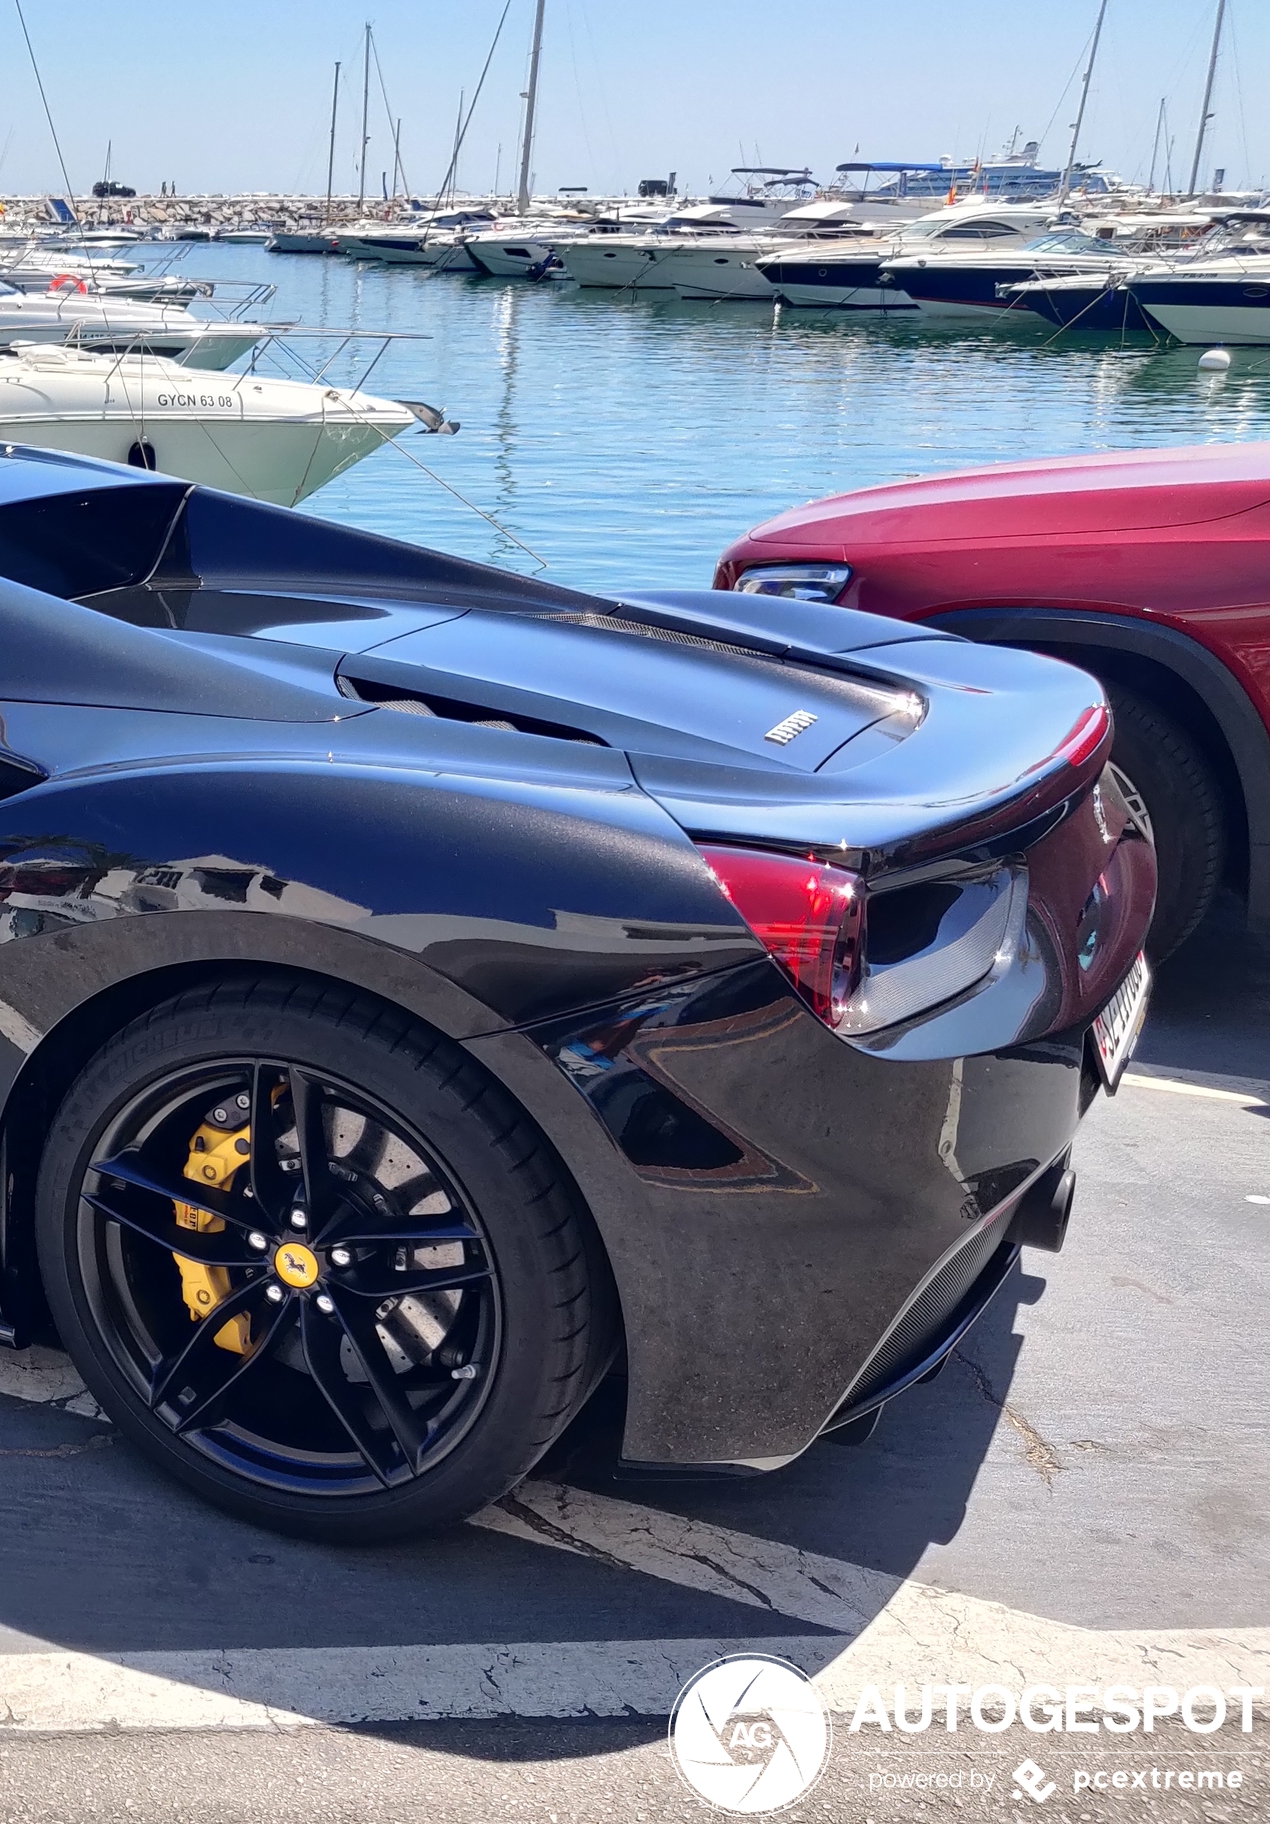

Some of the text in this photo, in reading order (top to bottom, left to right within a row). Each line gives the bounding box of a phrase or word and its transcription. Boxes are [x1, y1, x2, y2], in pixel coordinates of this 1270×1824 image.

[157, 394, 233, 408] GYCN 63 08
